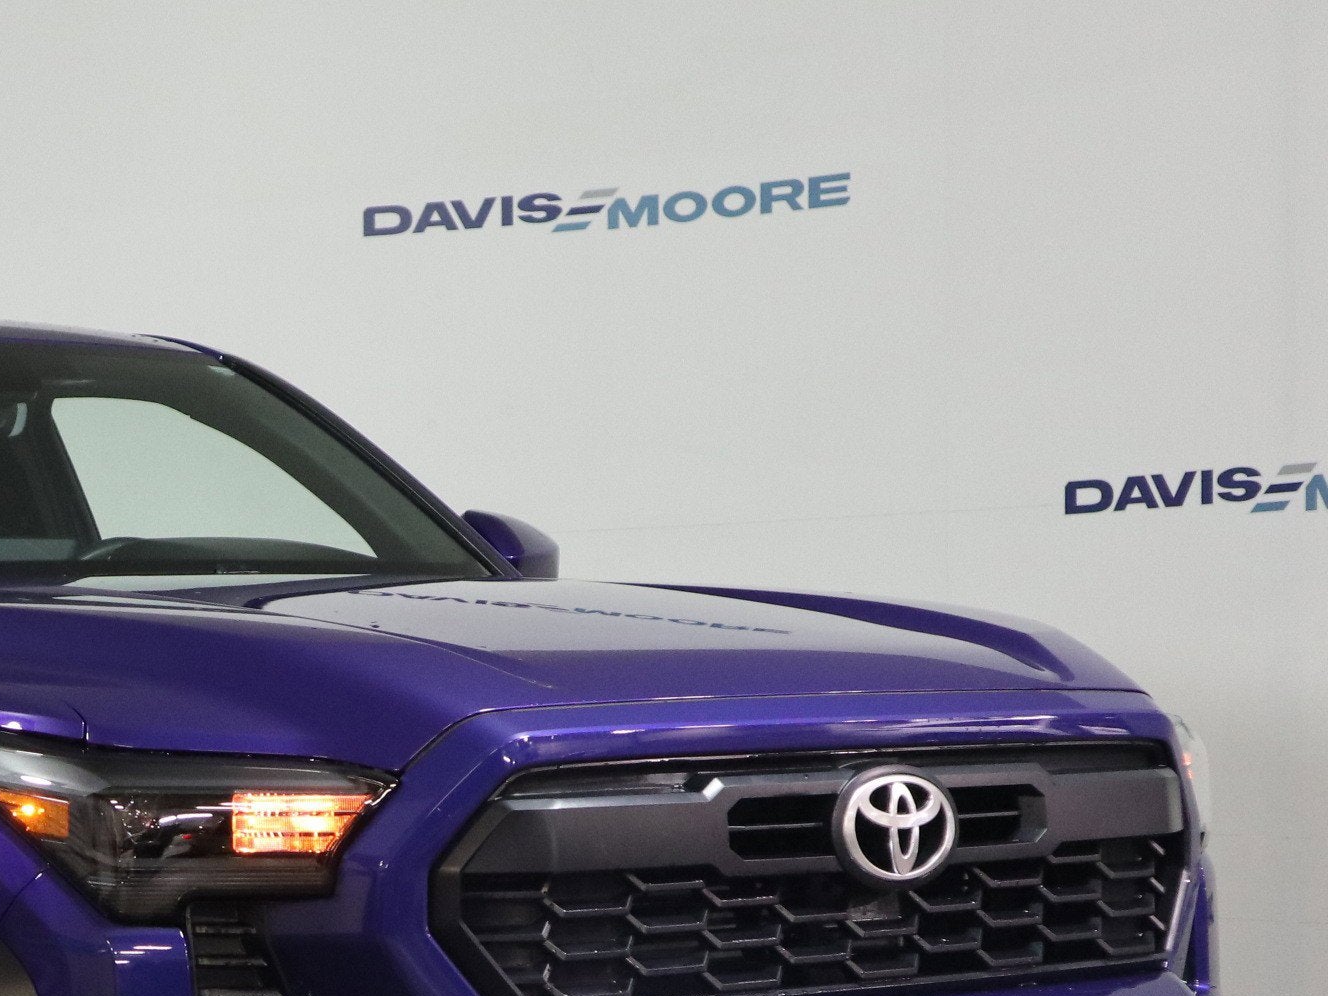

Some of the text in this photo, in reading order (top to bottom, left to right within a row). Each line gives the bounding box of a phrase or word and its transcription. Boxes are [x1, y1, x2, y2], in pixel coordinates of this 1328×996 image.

[362, 171, 851, 238] DAVIS MOORE
[1063, 465, 1263, 516] DAVIS
